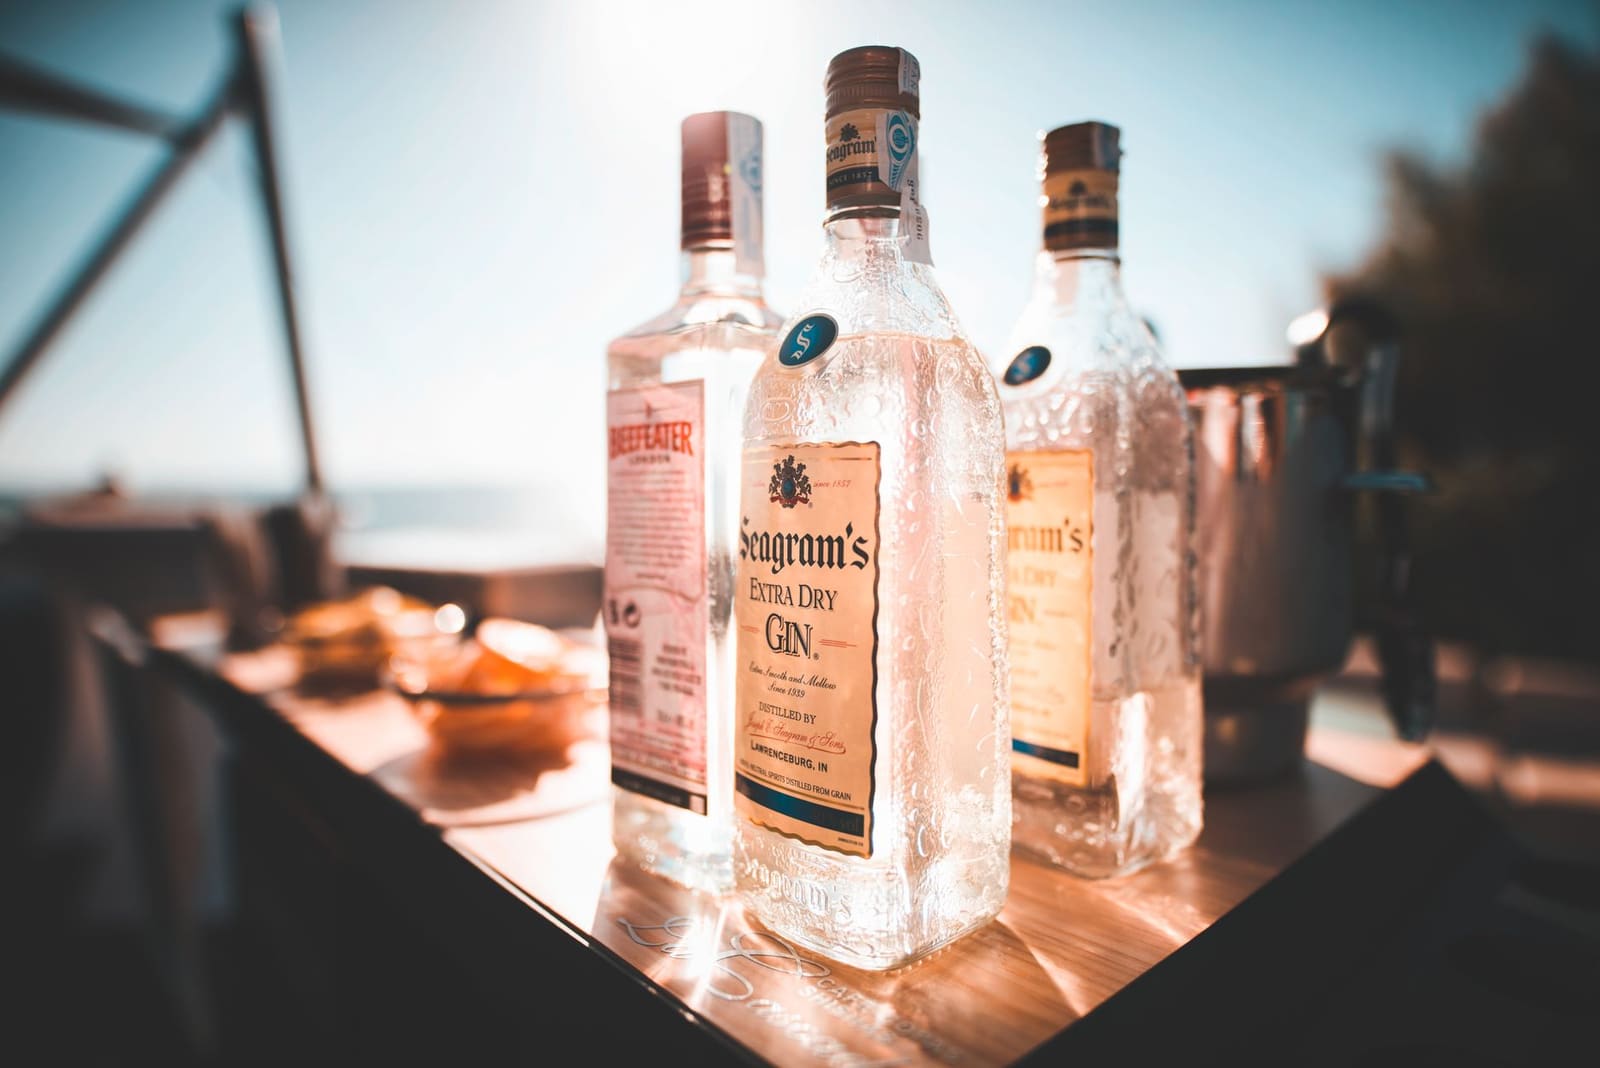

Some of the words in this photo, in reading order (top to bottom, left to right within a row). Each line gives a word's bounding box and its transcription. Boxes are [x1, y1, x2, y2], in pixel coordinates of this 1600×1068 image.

[827, 137, 877, 162] eagram'
[608, 421, 694, 459] BEEFEATER
[739, 516, 870, 575] Seagram's
[749, 577, 794, 606] EXTRA
[798, 584, 838, 611] DRY
[765, 612, 814, 660] GIN
[768, 681, 787, 695] Since
[787, 687, 806, 698] 1939
[803, 674, 837, 690] Mellow
[758, 701, 802, 721] DISTILLED
[803, 713, 816, 725] BY
[750, 739, 816, 770] LAWRENCEBURG,
[817, 761, 828, 773] IN
[785, 777, 812, 792] DISTILLED
[812, 785, 830, 797] FROM
[830, 789, 852, 801] GRAIN
